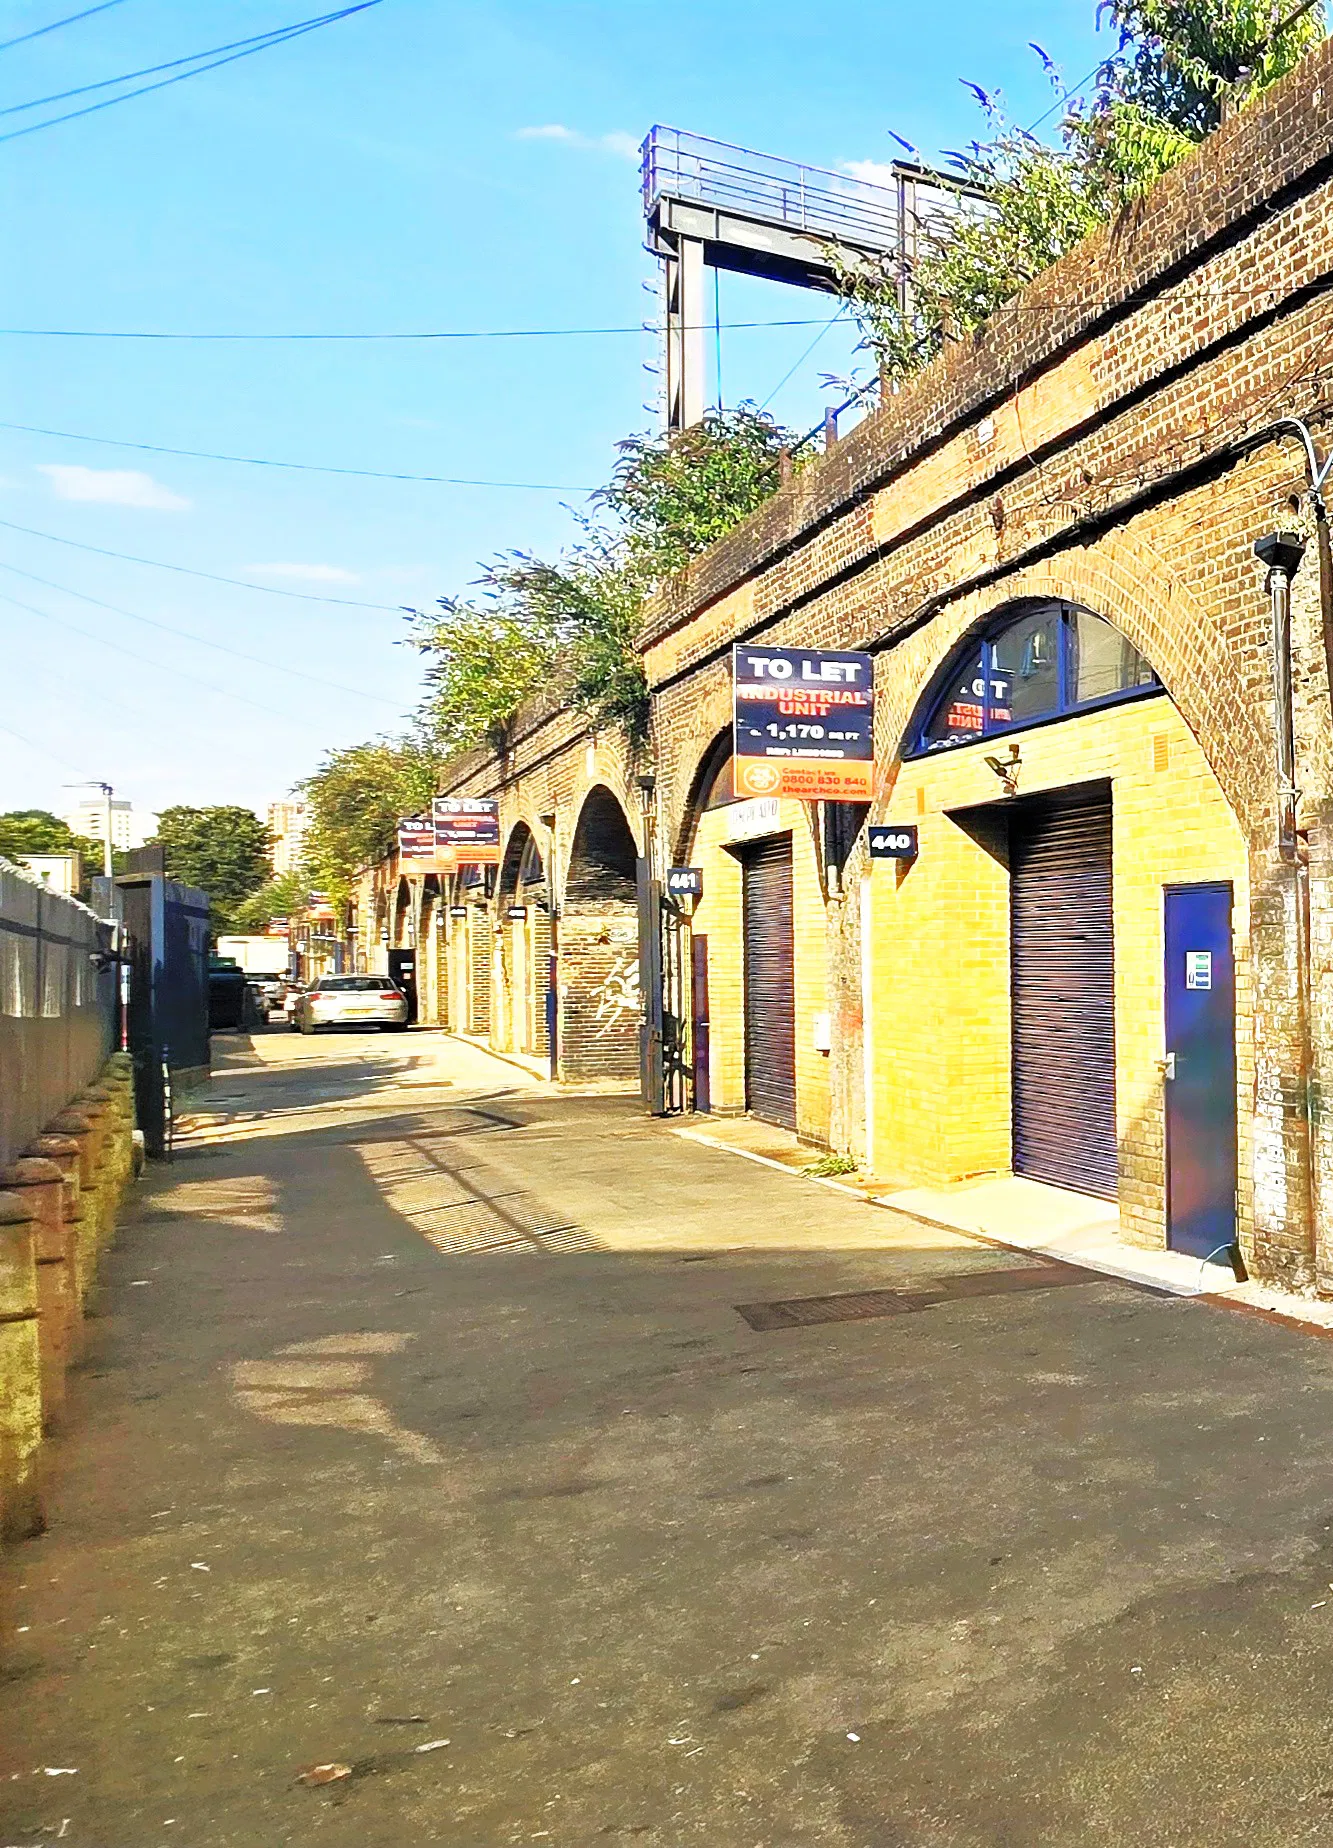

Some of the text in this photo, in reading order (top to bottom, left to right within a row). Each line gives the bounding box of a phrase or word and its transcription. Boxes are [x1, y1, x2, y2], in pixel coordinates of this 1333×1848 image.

[747, 656, 862, 682] TO LET
[741, 686, 868, 705] INDUSTRIAL
[779, 701, 831, 716] UNIT
[766, 723, 825, 740] 1,170
[782, 775, 814, 784] 0800
[817, 776, 841, 785] 830
[844, 777, 867, 786] 840
[782, 786, 867, 795] thearchco.com
[871, 834, 910, 850] 440
[669, 873, 697, 889] 441
